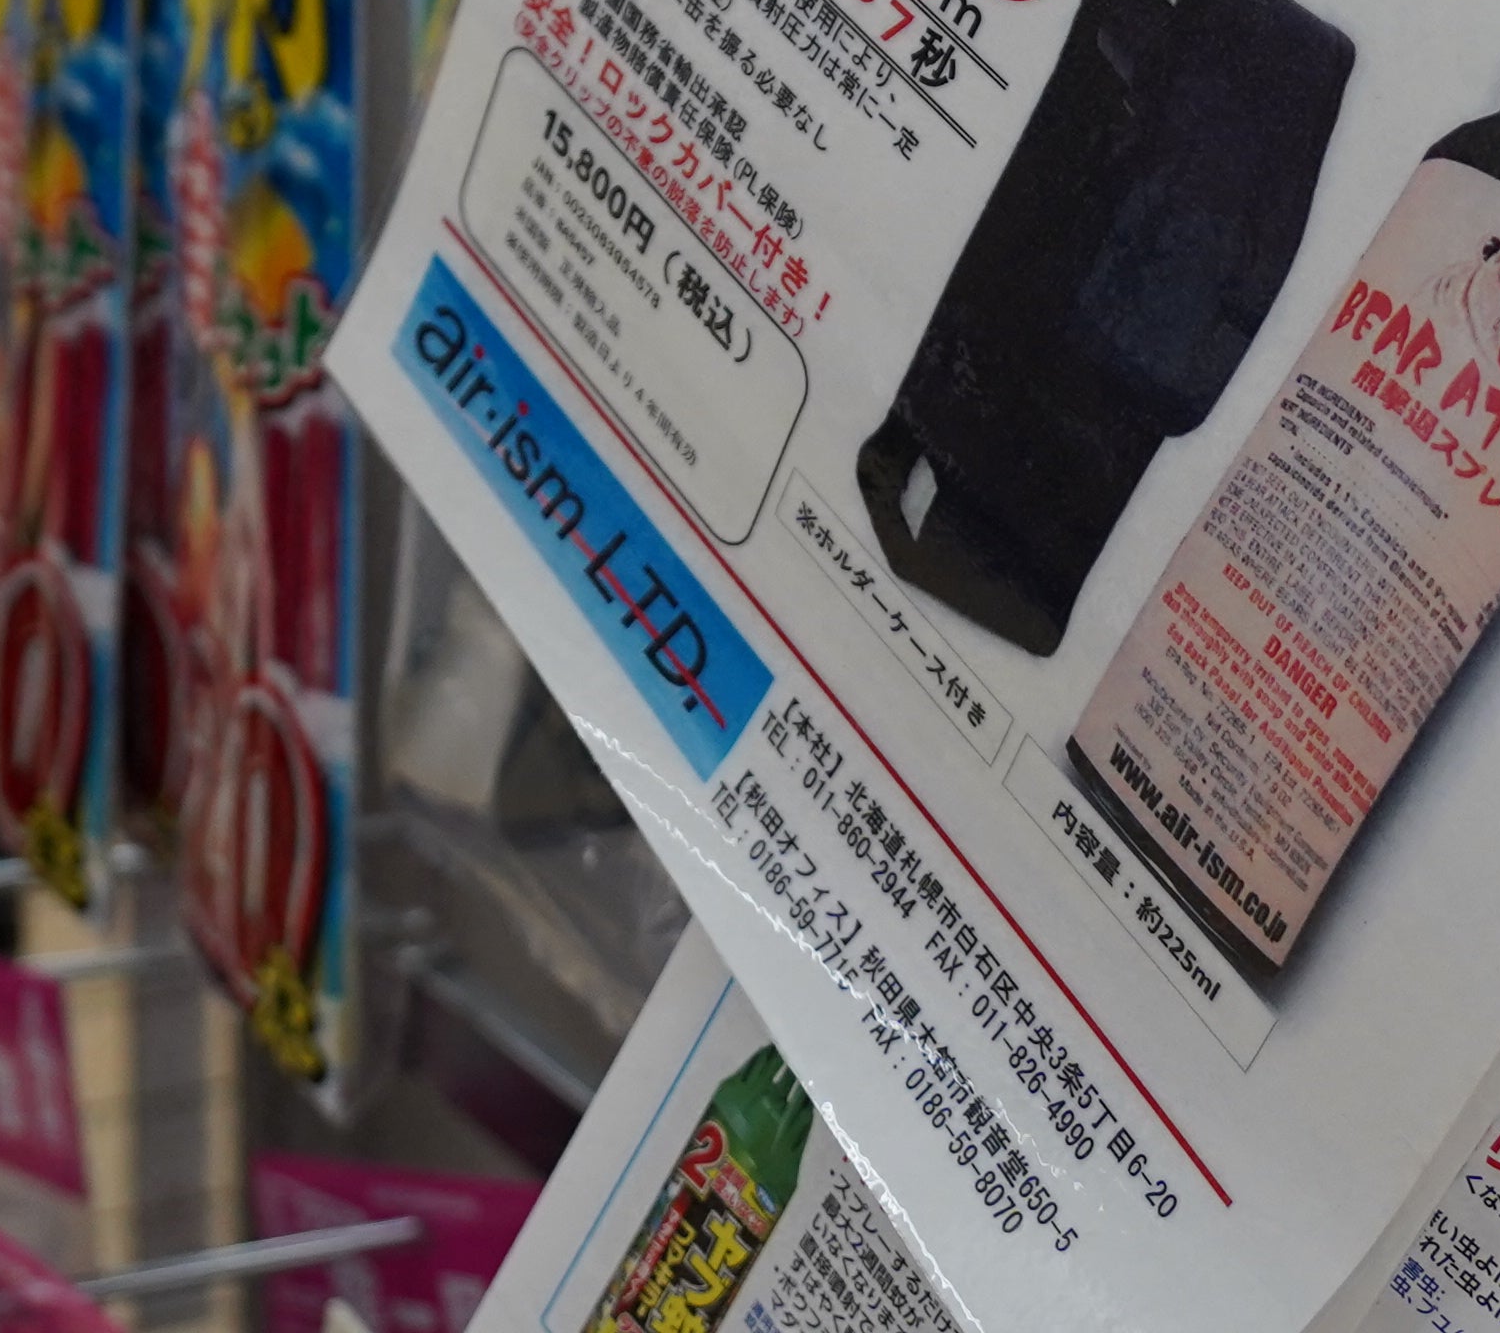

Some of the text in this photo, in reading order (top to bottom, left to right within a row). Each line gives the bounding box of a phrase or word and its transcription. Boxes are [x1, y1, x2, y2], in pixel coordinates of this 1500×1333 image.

[1329, 277, 1446, 395] BEAR
[1262, 632, 1339, 720] DANGER
[1108, 739, 1290, 947] www.air-ism.co.jp
